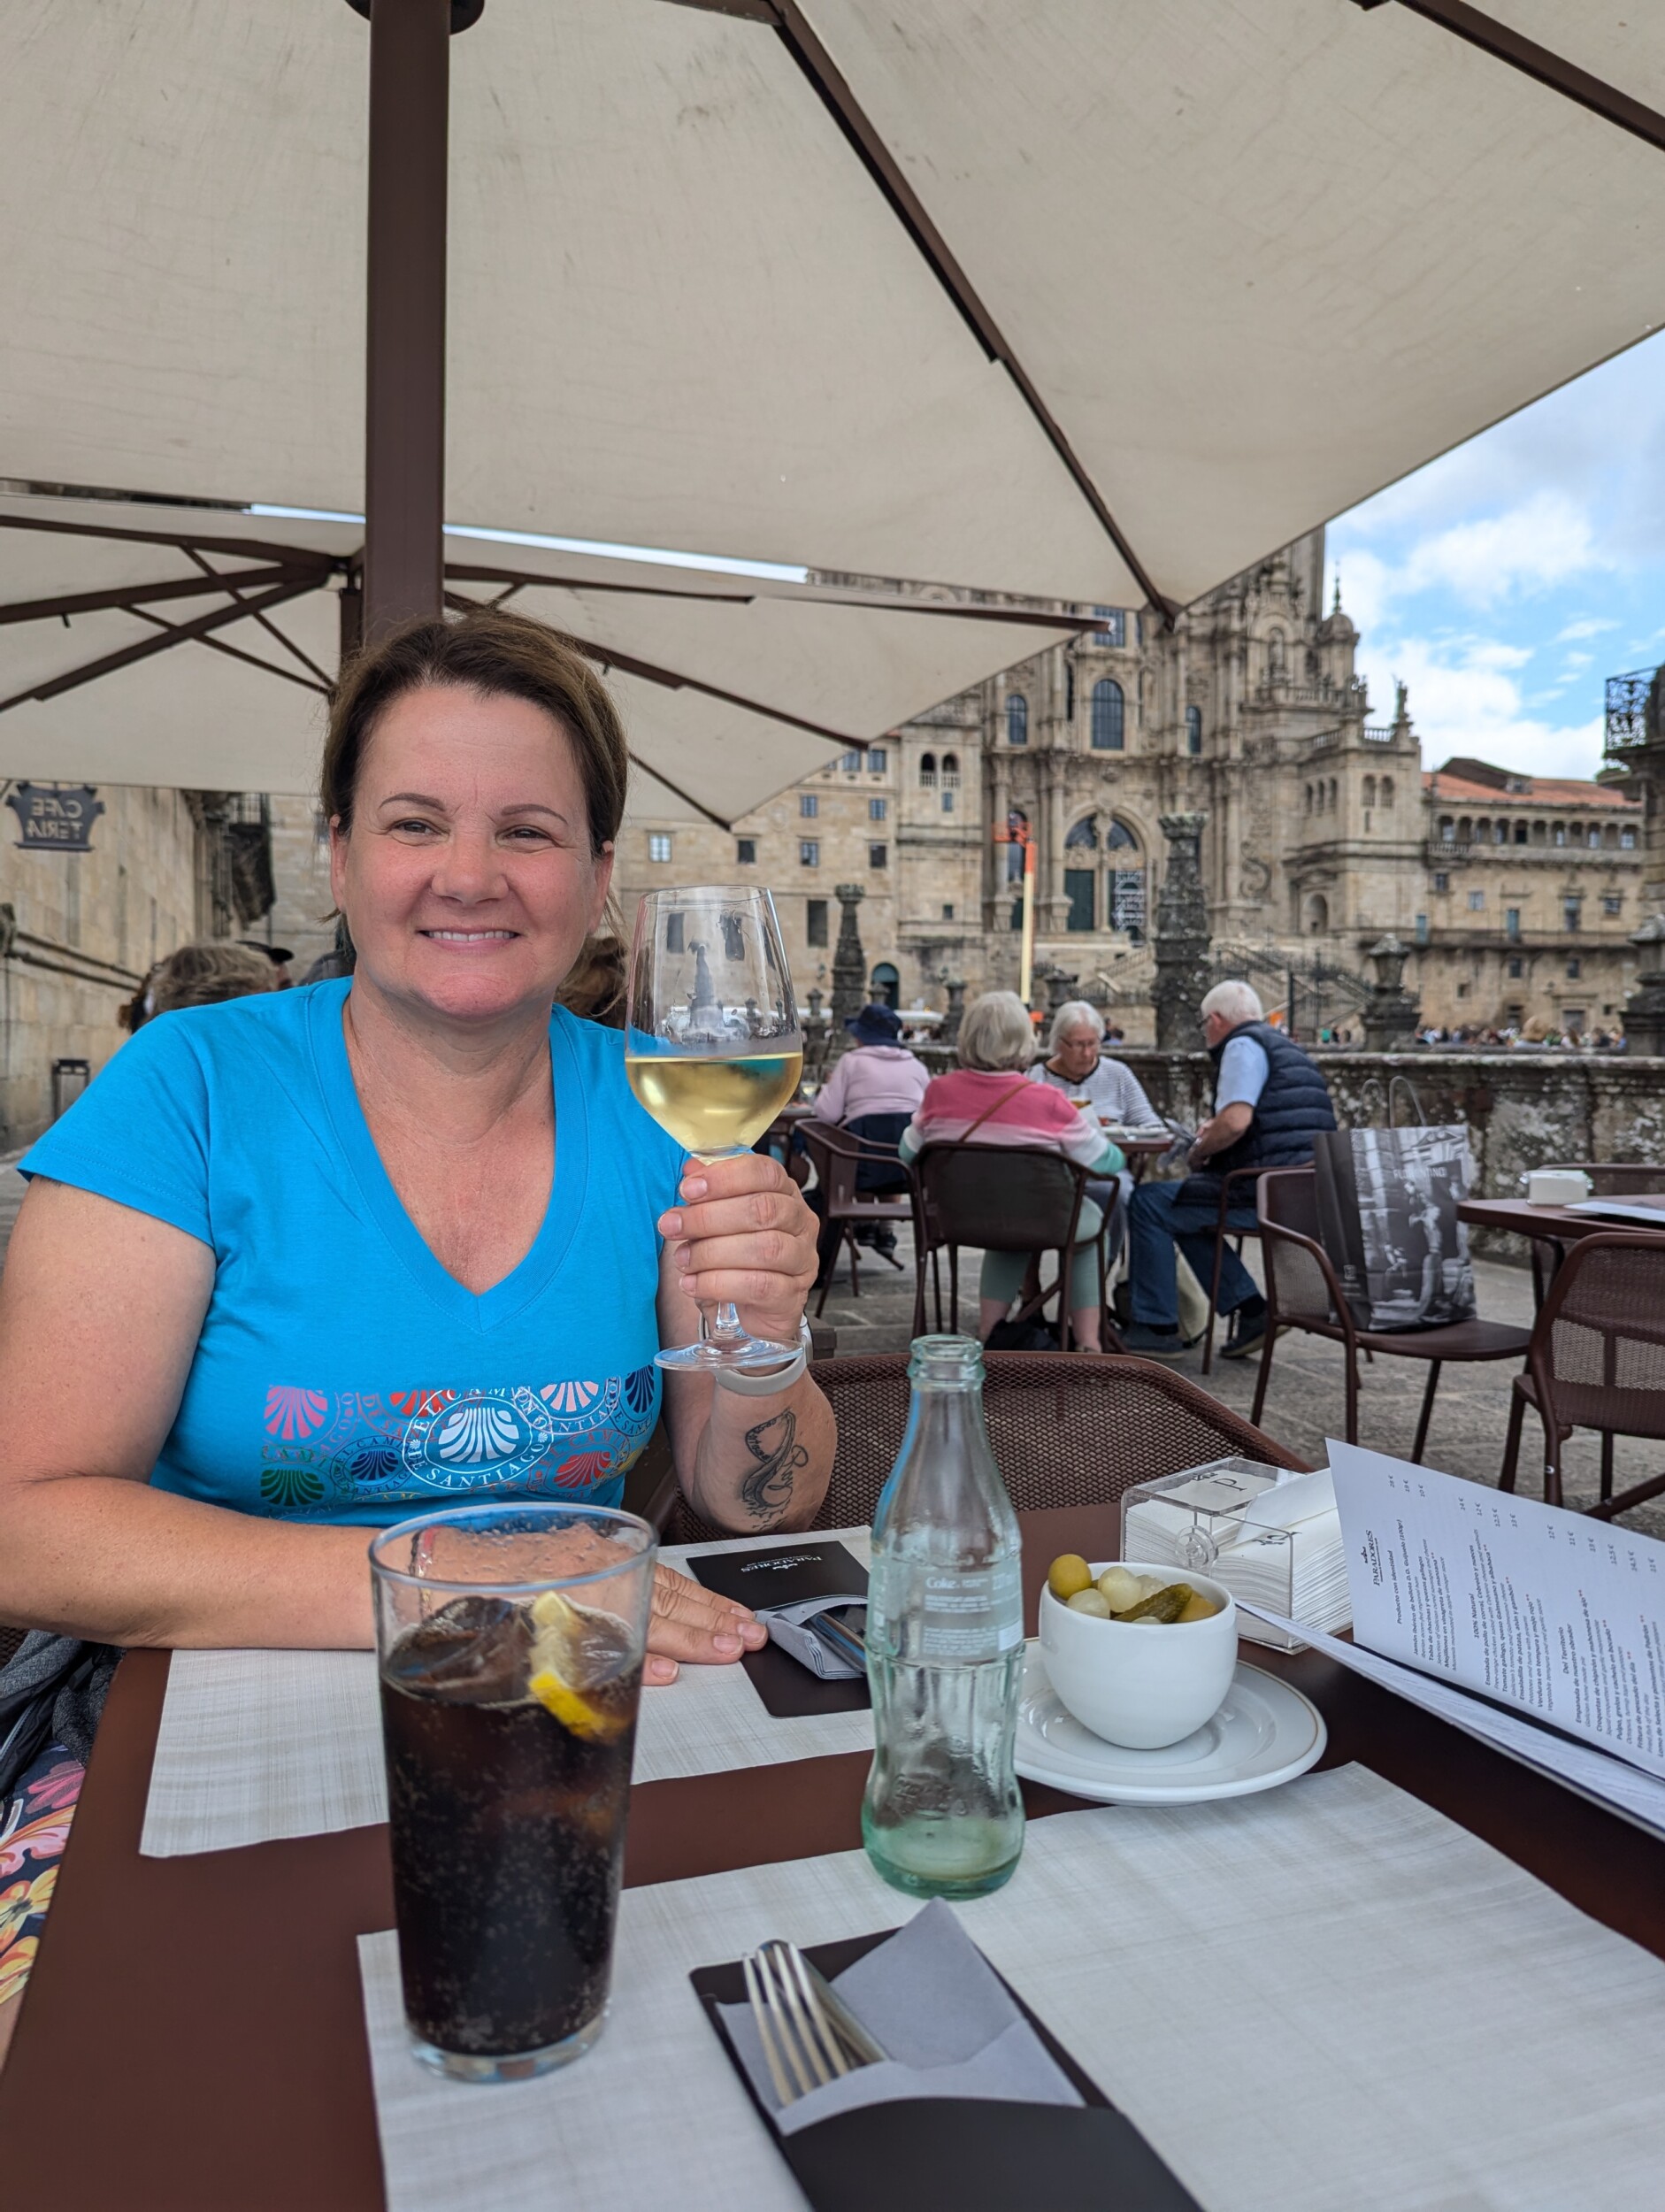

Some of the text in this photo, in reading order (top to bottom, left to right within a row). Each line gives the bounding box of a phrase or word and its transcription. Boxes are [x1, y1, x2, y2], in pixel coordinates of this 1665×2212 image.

[413, 1403, 442, 1433] EL
[426, 1443, 545, 1488] SANTIAGO
[1366, 1530, 1380, 1586] PARADORES
[1400, 1541, 1409, 1567] Guijuelo
[1387, 1549, 1397, 1581] identidad
[1418, 1555, 1427, 1581] gallegos
[925, 1576, 956, 1589] Coke
[1437, 1586, 1443, 1595] de
[1410, 1603, 1416, 1612] de
[1469, 1593, 1477, 1619] Natural
[1583, 1609, 1589, 1617] de
[1442, 1625, 1447, 1634] en
[1481, 1620, 1487, 1630] de
[1427, 1634, 1433, 1644] de
[1567, 1624, 1576, 1650] obrador
[1584, 1618, 1595, 1653] mahonesa
[1558, 1626, 1568, 1660] Territorio
[1484, 1647, 1490, 1656] de
[1646, 1649, 1653, 1660] de
[1516, 1655, 1523, 1665] de
[1609, 1654, 1615, 1663] en
[1536, 1667, 1542, 1678] en
[1591, 1658, 1600, 1686] chipirón
[1610, 1663, 1619, 1690] cachelo
[1649, 1660, 1658, 1695] pimientos
[1573, 1678, 1580, 1687] de
[1593, 1686, 1600, 1697] de
[1632, 1686, 1642, 1715] pescado
[1635, 1715, 1642, 1724] de
[1656, 1726, 1662, 1737] de
